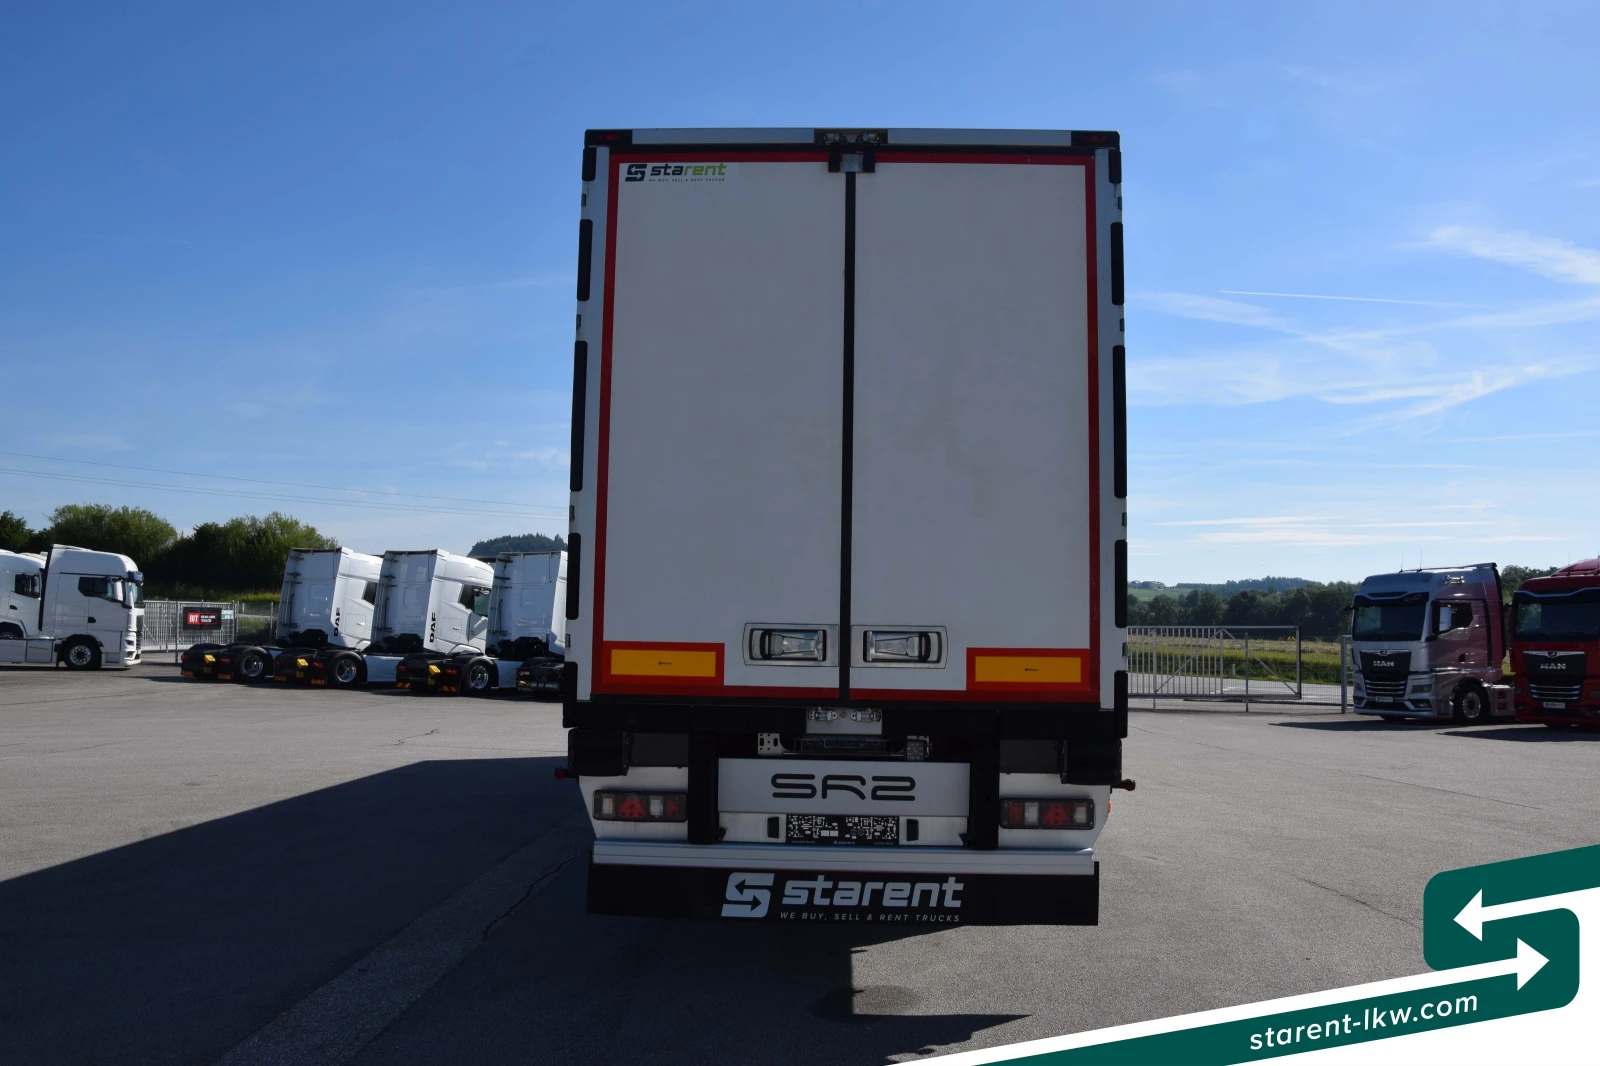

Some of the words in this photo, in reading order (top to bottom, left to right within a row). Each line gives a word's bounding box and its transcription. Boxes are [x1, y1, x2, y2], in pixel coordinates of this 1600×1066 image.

[650, 163, 727, 176] starent
[333, 607, 341, 636] DAF
[770, 773, 916, 801] SR2
[781, 874, 964, 908] starent
[780, 911, 796, 919] WE
[801, 912, 827, 921] BUY,
[834, 913, 861, 921] SELL
[866, 913, 873, 921] &
[915, 914, 960, 922] TRUCKS
